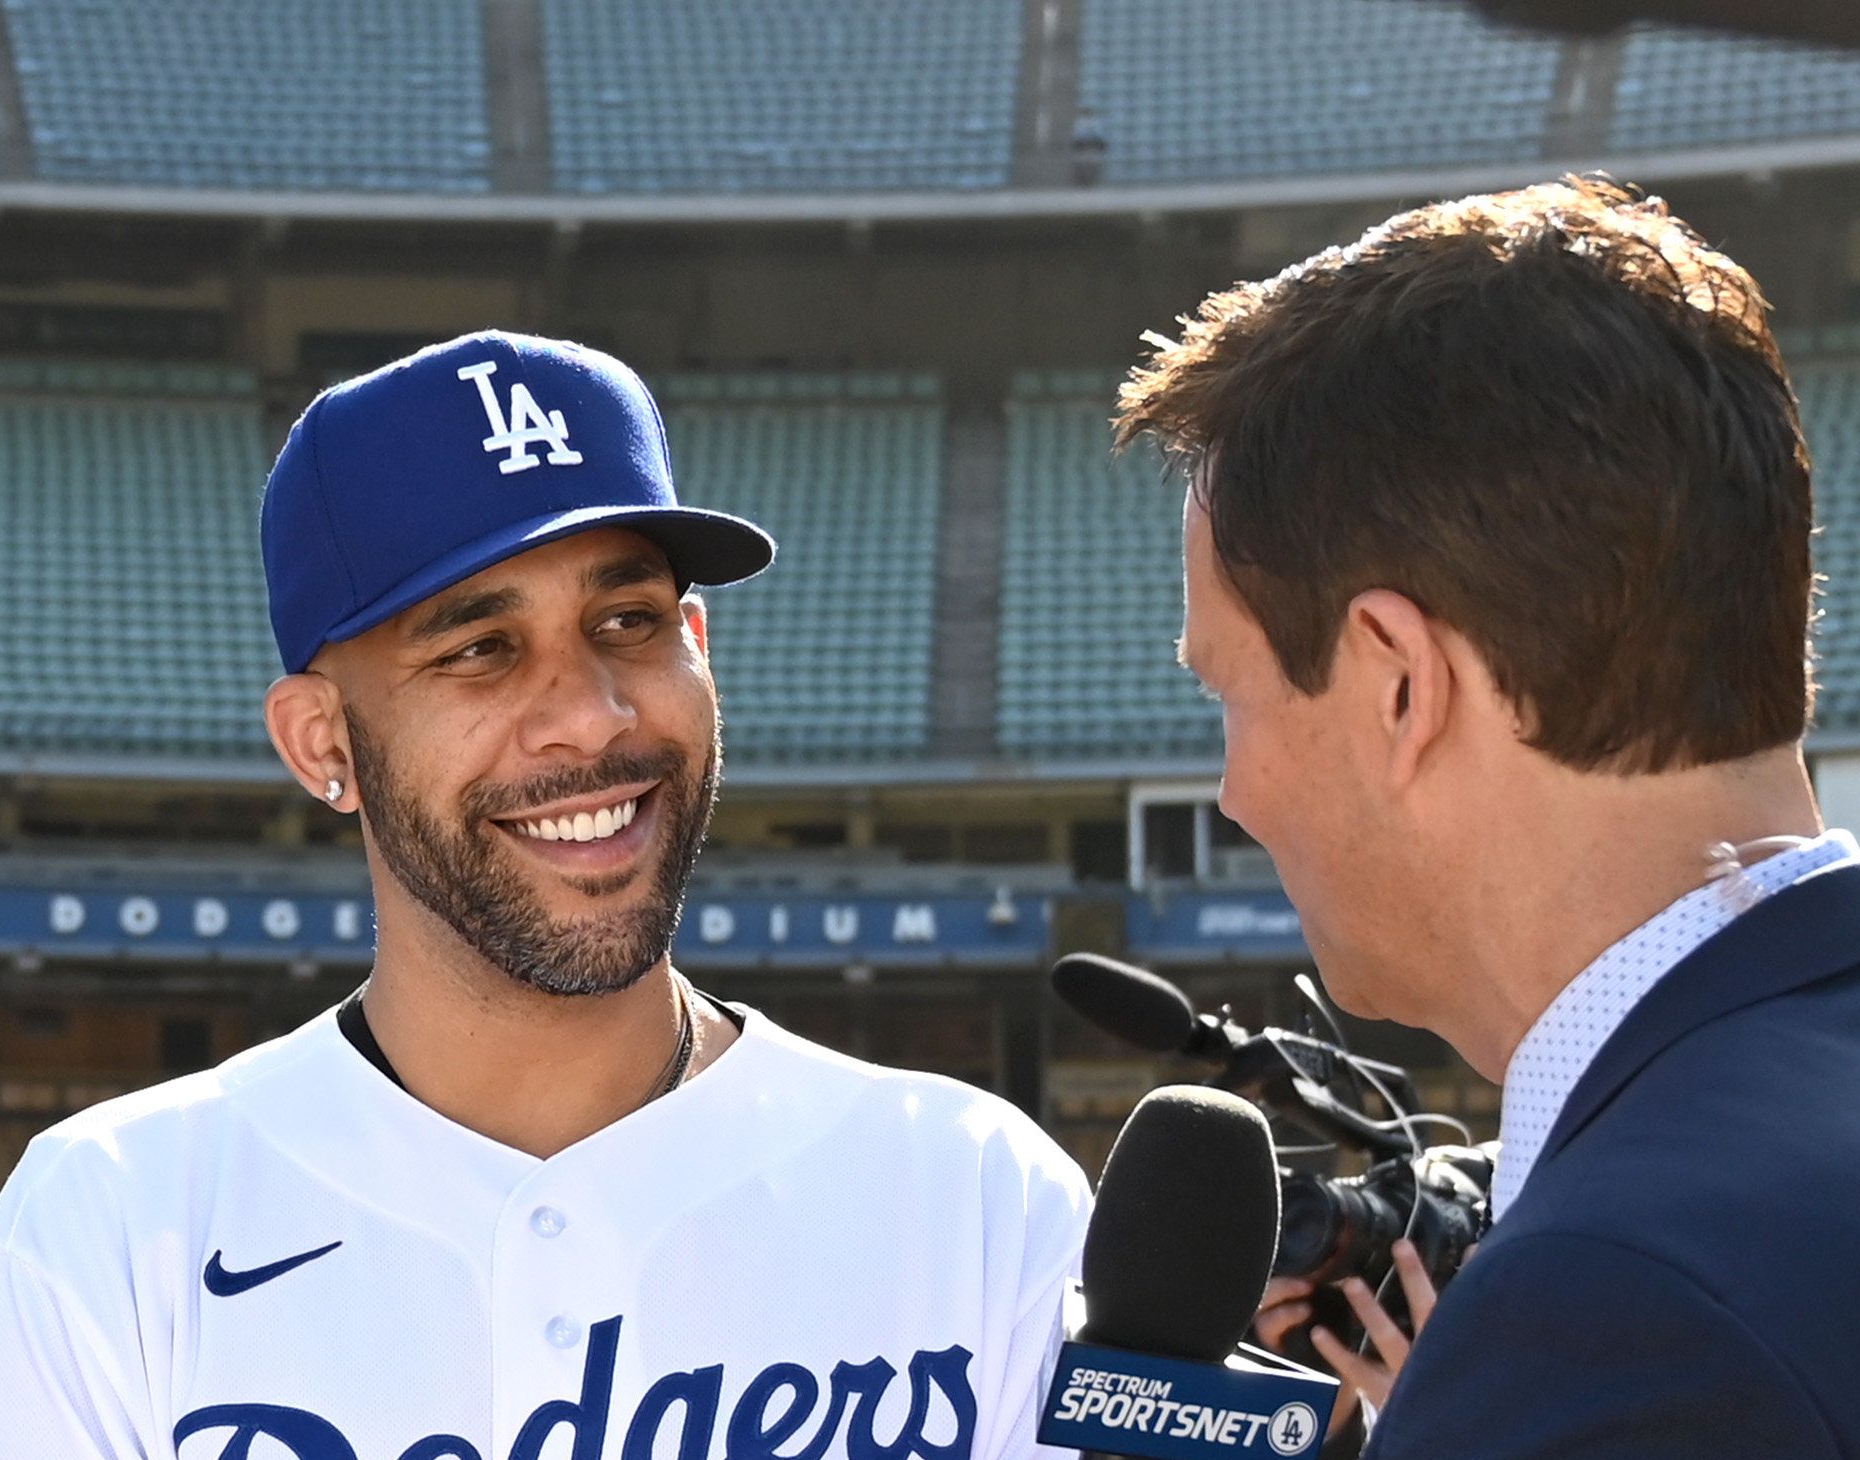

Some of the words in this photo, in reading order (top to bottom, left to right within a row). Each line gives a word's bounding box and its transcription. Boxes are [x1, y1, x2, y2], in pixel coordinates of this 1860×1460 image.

[457, 360, 584, 475] LA
[49, 893, 361, 940] DODGE
[698, 904, 938, 943] DIUM
[1068, 1367, 1173, 1400] SPECTRUM
[1054, 1386, 1270, 1448] SPORTSNET
